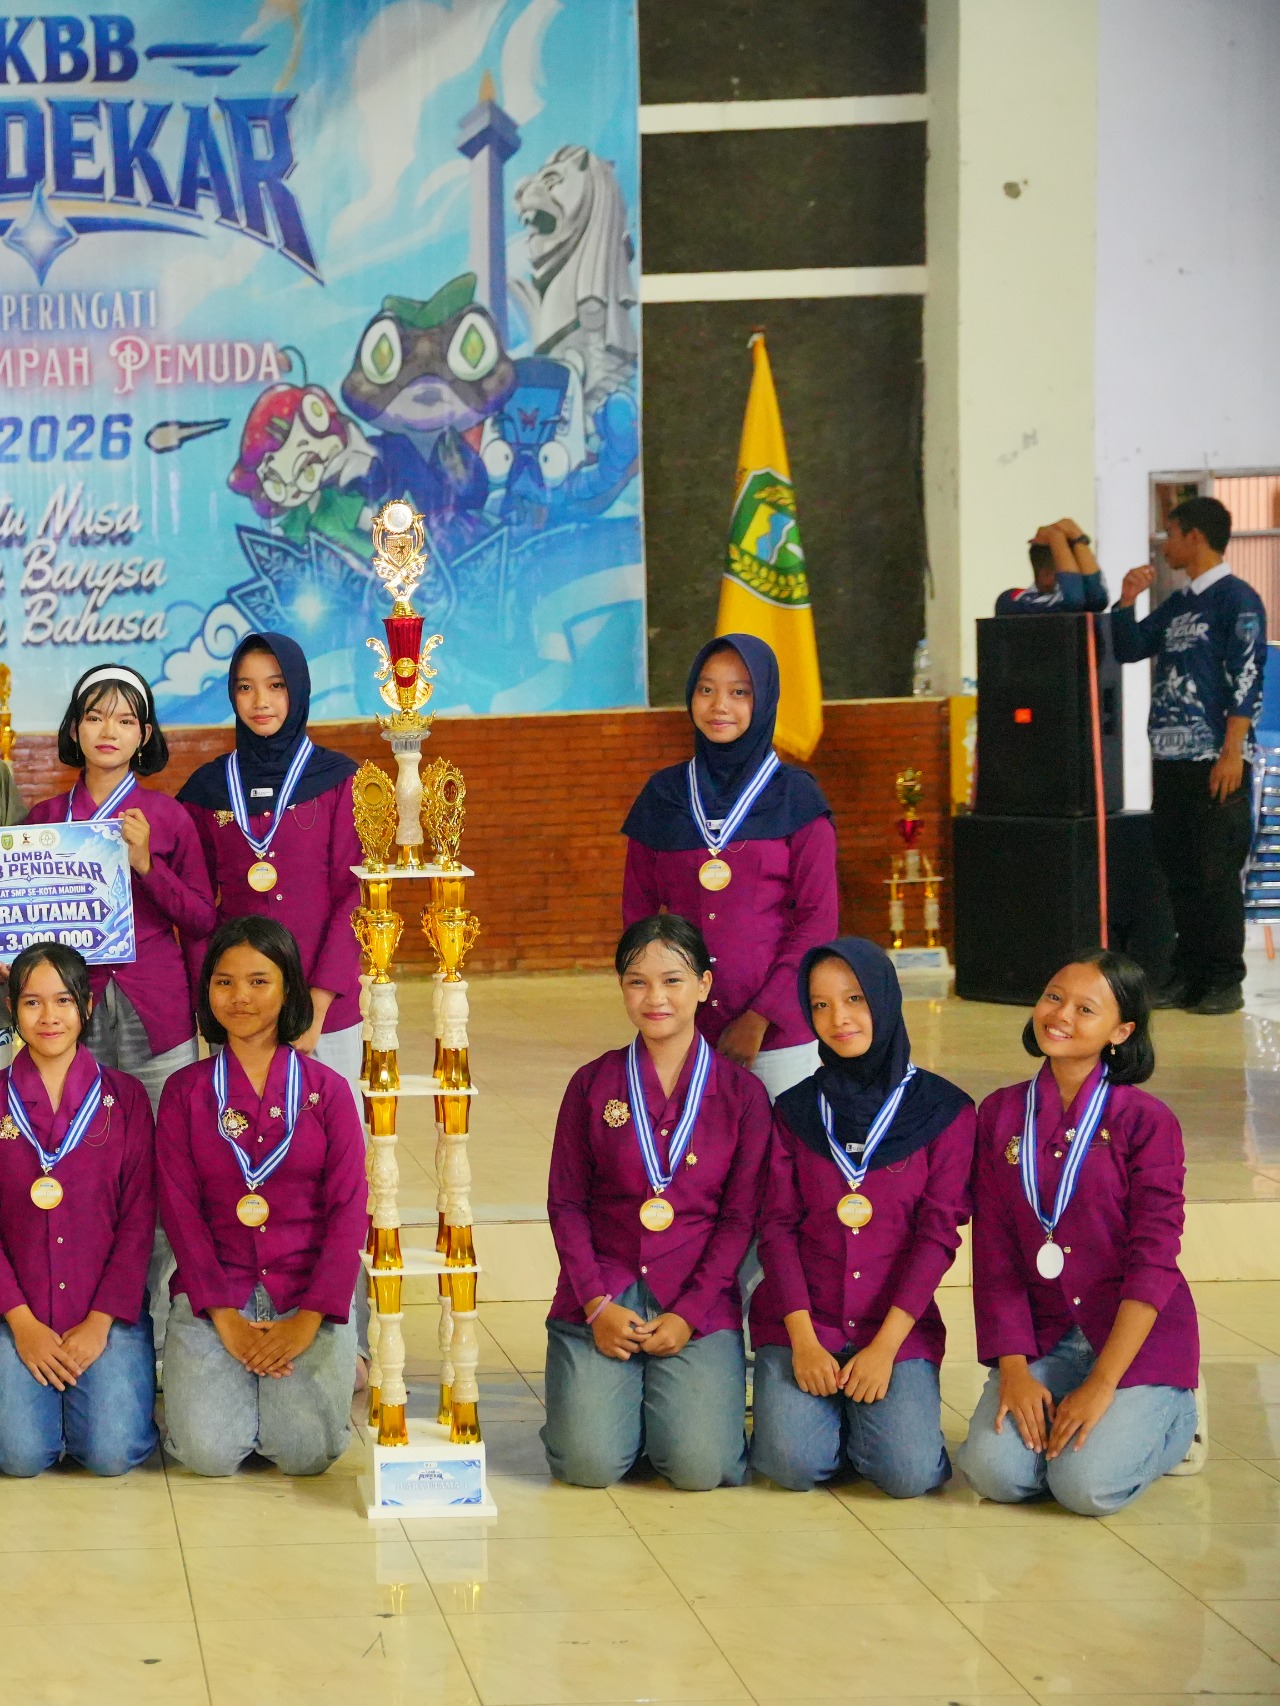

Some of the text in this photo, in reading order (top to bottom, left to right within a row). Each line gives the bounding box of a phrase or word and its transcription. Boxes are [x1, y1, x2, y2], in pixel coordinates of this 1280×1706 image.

[109, 335, 281, 395] PEMUDA
[37, 481, 141, 538] Nusa
[20, 539, 167, 608] Bangsa
[21, 588, 168, 644] Bahasa
[3, 850, 52, 863] LOMBA
[8, 861, 108, 886] PENDEKAR
[11, 888, 26, 897] SMP
[27, 887, 58, 897] SE-KOTA
[58, 885, 86, 895] MADIUN
[26, 902, 87, 924] UTAMA
[92, 901, 102, 921] 1
[6, 930, 94, 951] 3.000000
